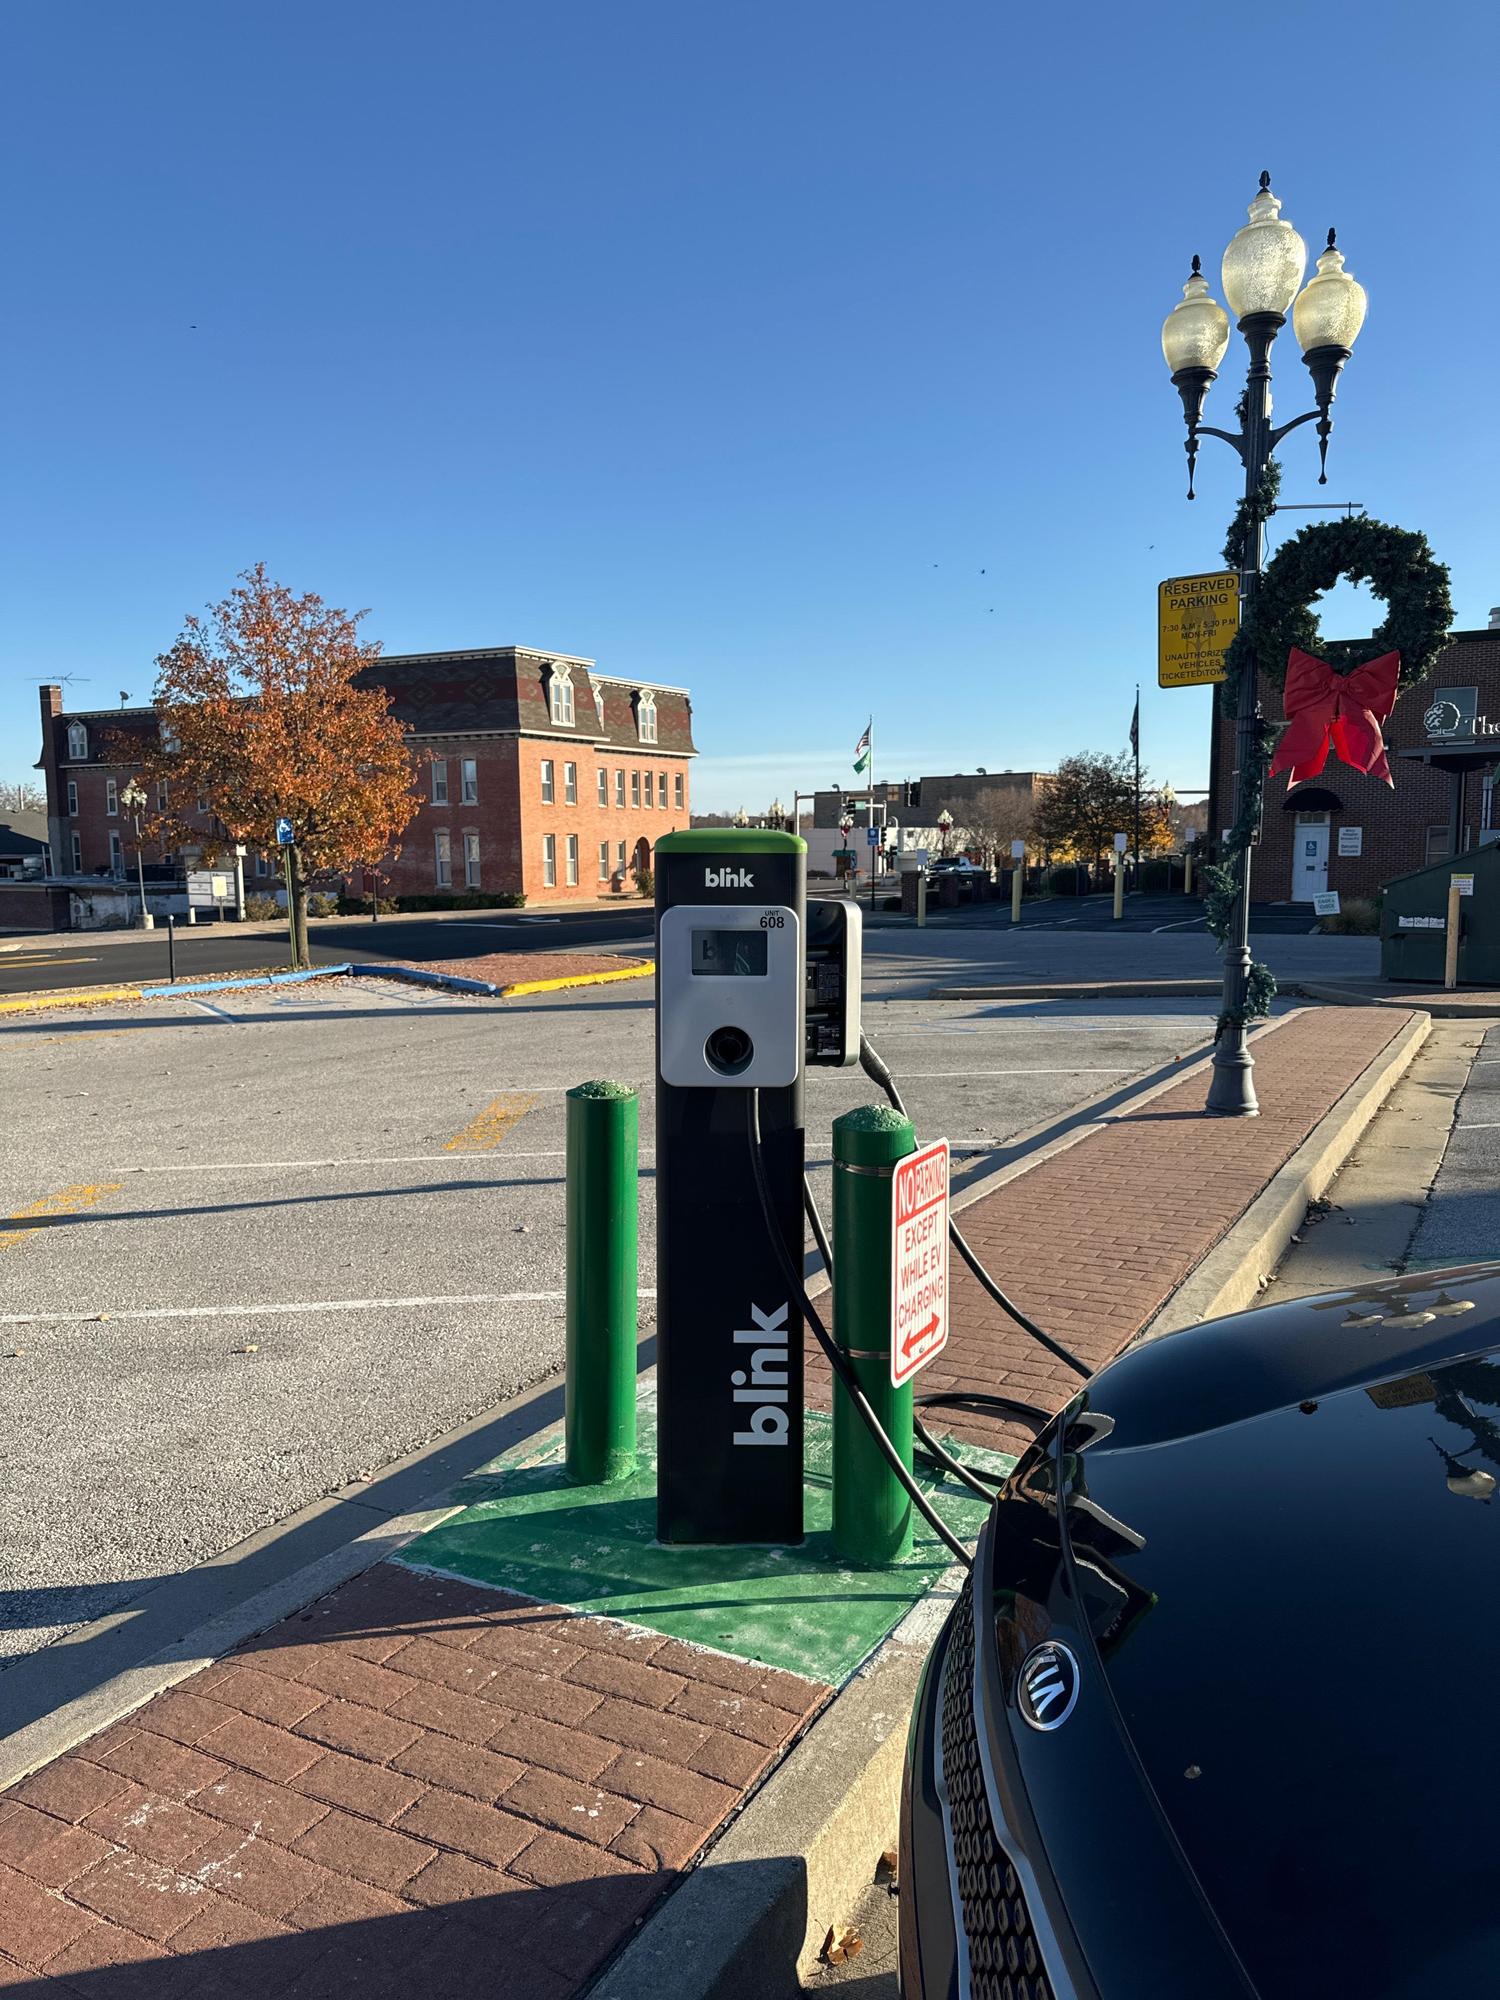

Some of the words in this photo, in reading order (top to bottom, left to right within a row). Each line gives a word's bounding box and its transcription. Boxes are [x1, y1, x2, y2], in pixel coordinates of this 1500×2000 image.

[1164, 578, 1235, 596] RESERVED
[1170, 593, 1228, 609] PARKING
[1165, 649, 1226, 662] UNAUTHORIZE
[1178, 659, 1221, 670] VEHICLES
[705, 867, 754, 888] blink
[760, 916, 785, 929] 608
[899, 1168, 915, 1220] NO
[916, 1154, 945, 1206] PARKING
[905, 1211, 938, 1253] EXCEPT
[901, 1251, 928, 1291] WHILE
[931, 1242, 941, 1271] EV
[898, 1275, 943, 1329] CHARGING
[731, 1301, 790, 1445] blink
